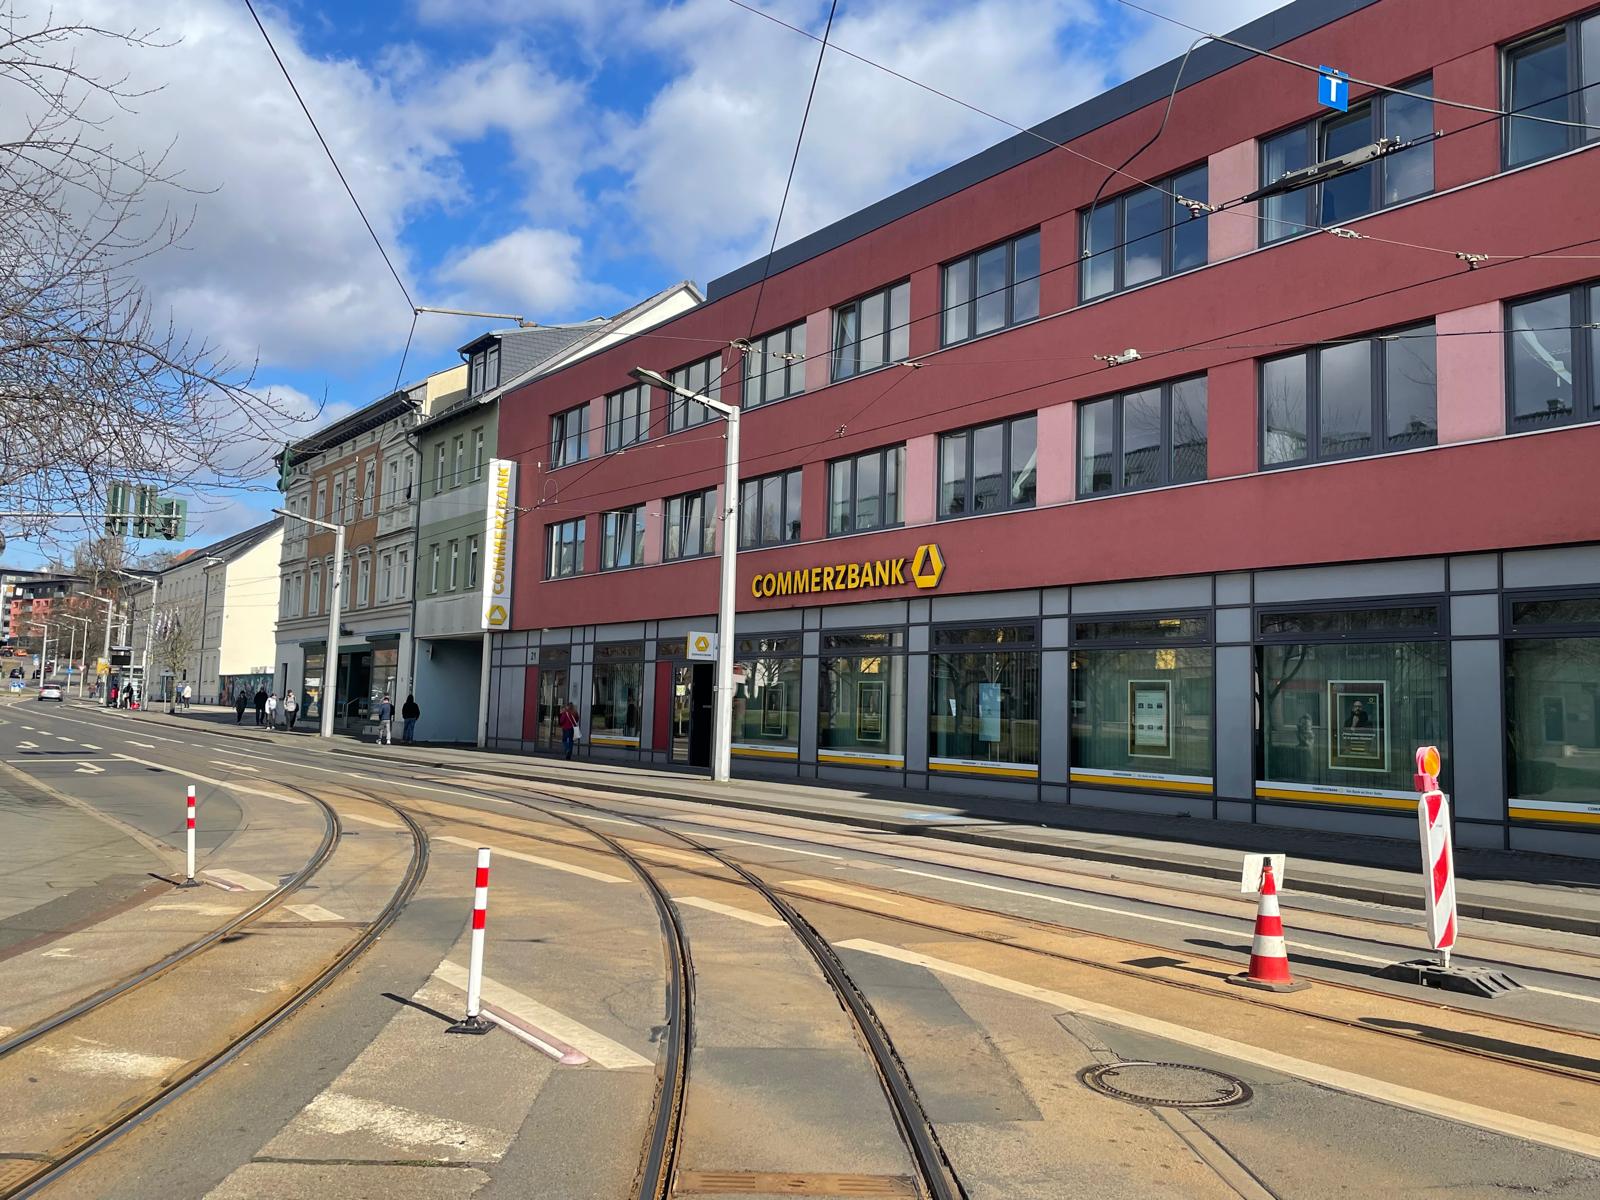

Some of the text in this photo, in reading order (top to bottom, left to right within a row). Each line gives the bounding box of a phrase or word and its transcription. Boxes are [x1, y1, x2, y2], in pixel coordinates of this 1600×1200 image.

[1325, 76, 1343, 102] T
[491, 467, 510, 596] COMMERZBANK
[750, 557, 906, 600] COMMERZBANK
